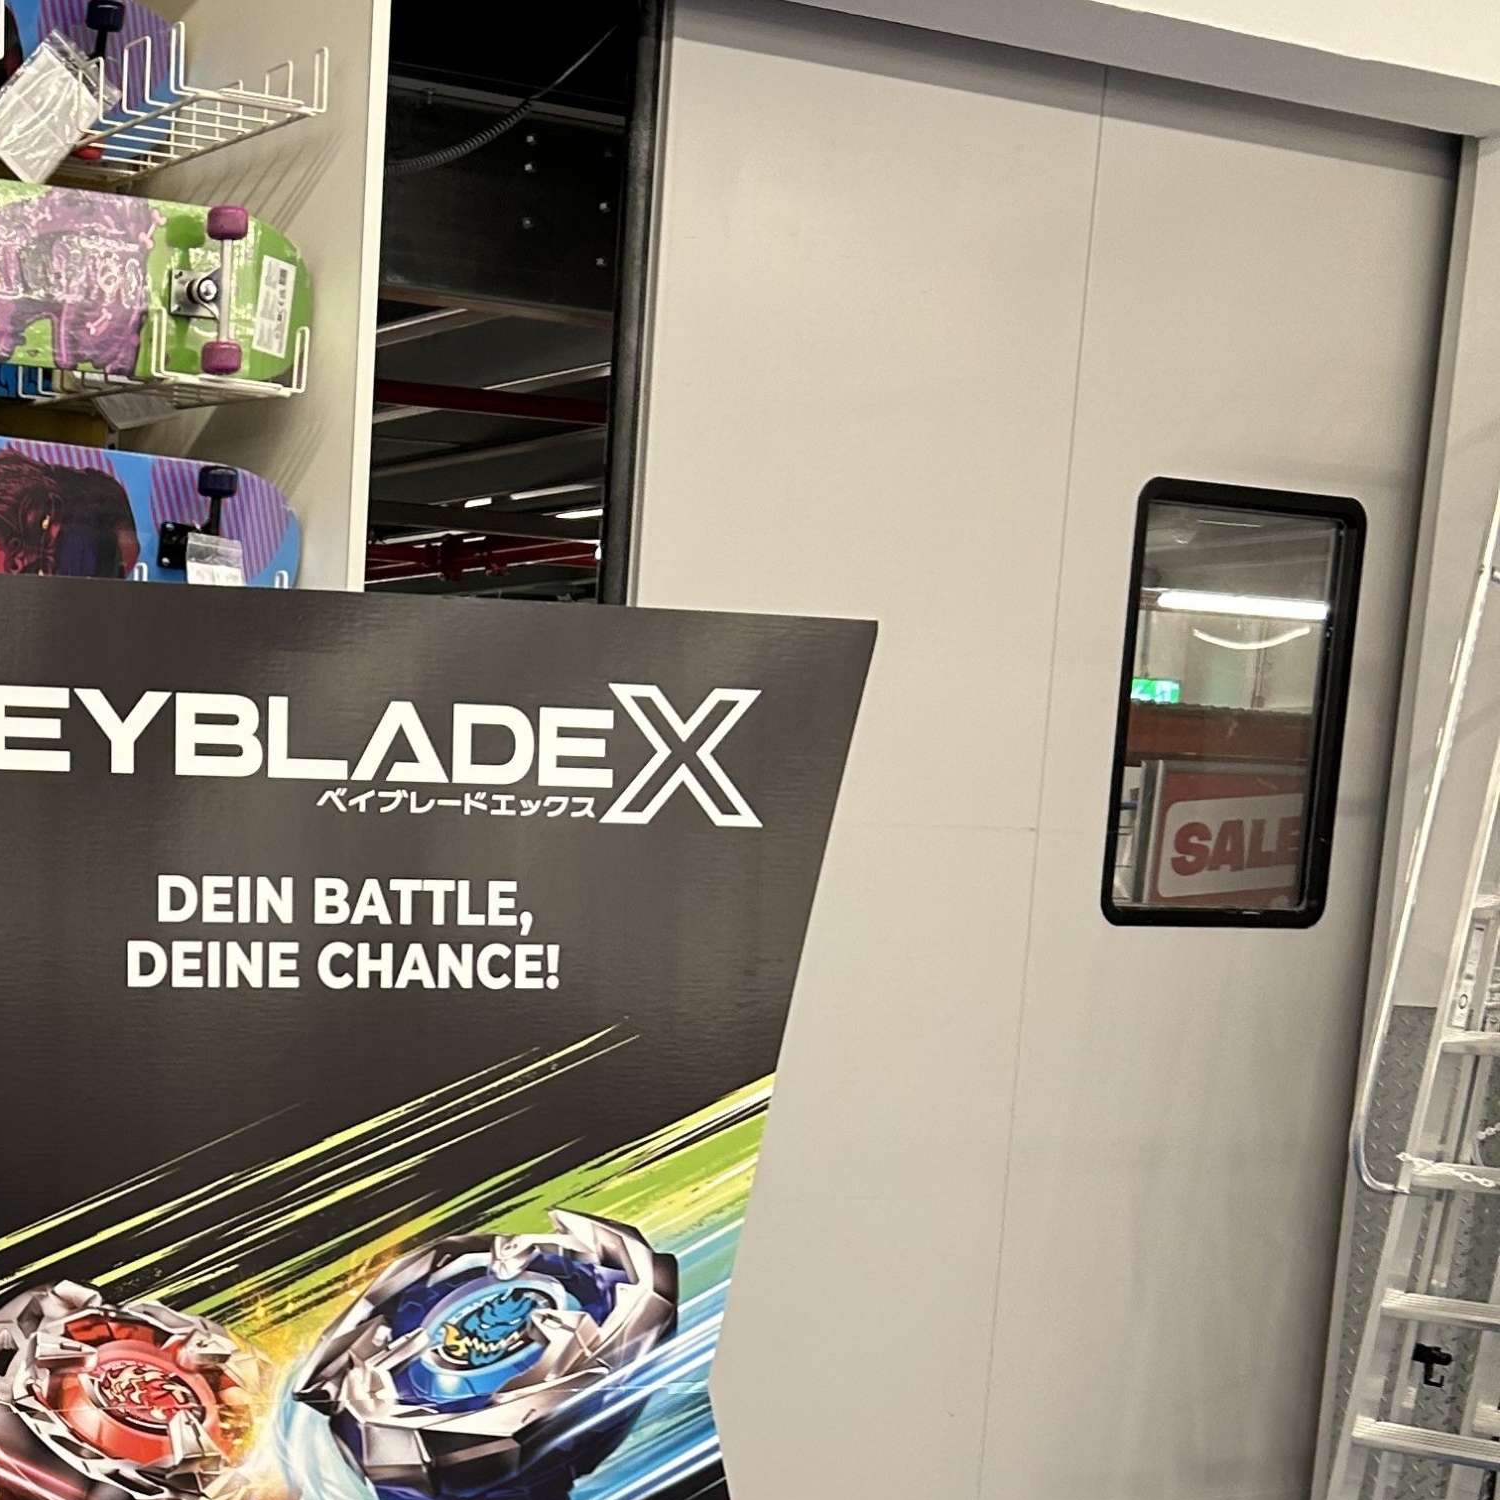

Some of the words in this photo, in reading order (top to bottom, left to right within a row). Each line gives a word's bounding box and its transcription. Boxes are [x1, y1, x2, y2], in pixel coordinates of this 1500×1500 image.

[316, 787, 596, 818] ベイブレードエックス
[1171, 816, 1301, 876] SALE
[158, 875, 293, 923] DEIN
[314, 877, 533, 936] BATTLE,
[127, 940, 299, 988] DEINE
[317, 942, 560, 989] CHANCE!
